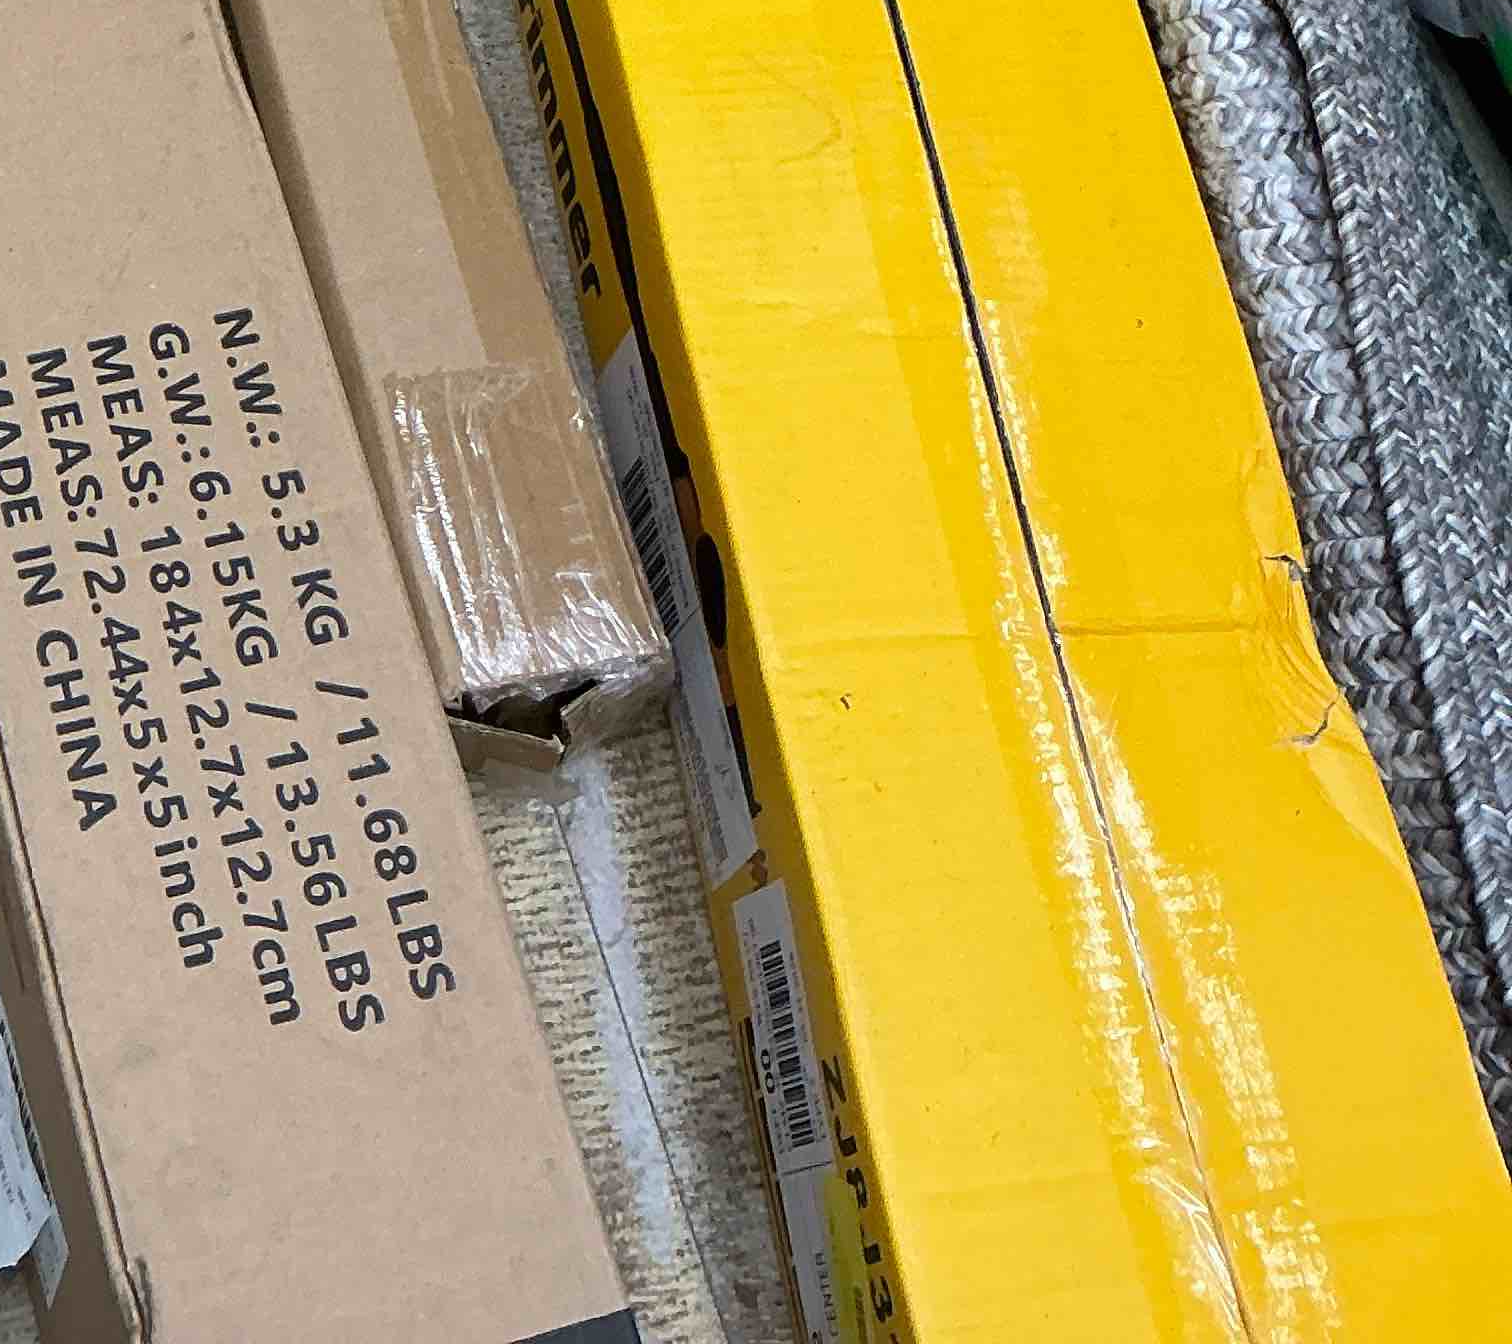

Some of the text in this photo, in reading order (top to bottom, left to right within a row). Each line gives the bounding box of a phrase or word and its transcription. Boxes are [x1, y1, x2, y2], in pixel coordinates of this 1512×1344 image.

[12, 544, 65, 608] IN
[213, 307, 283, 448] N.W.:
[261, 469, 320, 552] 5.3
[292, 569, 351, 647] KG
[35, 629, 118, 832] CHINA
[87, 334, 302, 1026] MEAS: 184x12.7x12.7cm
